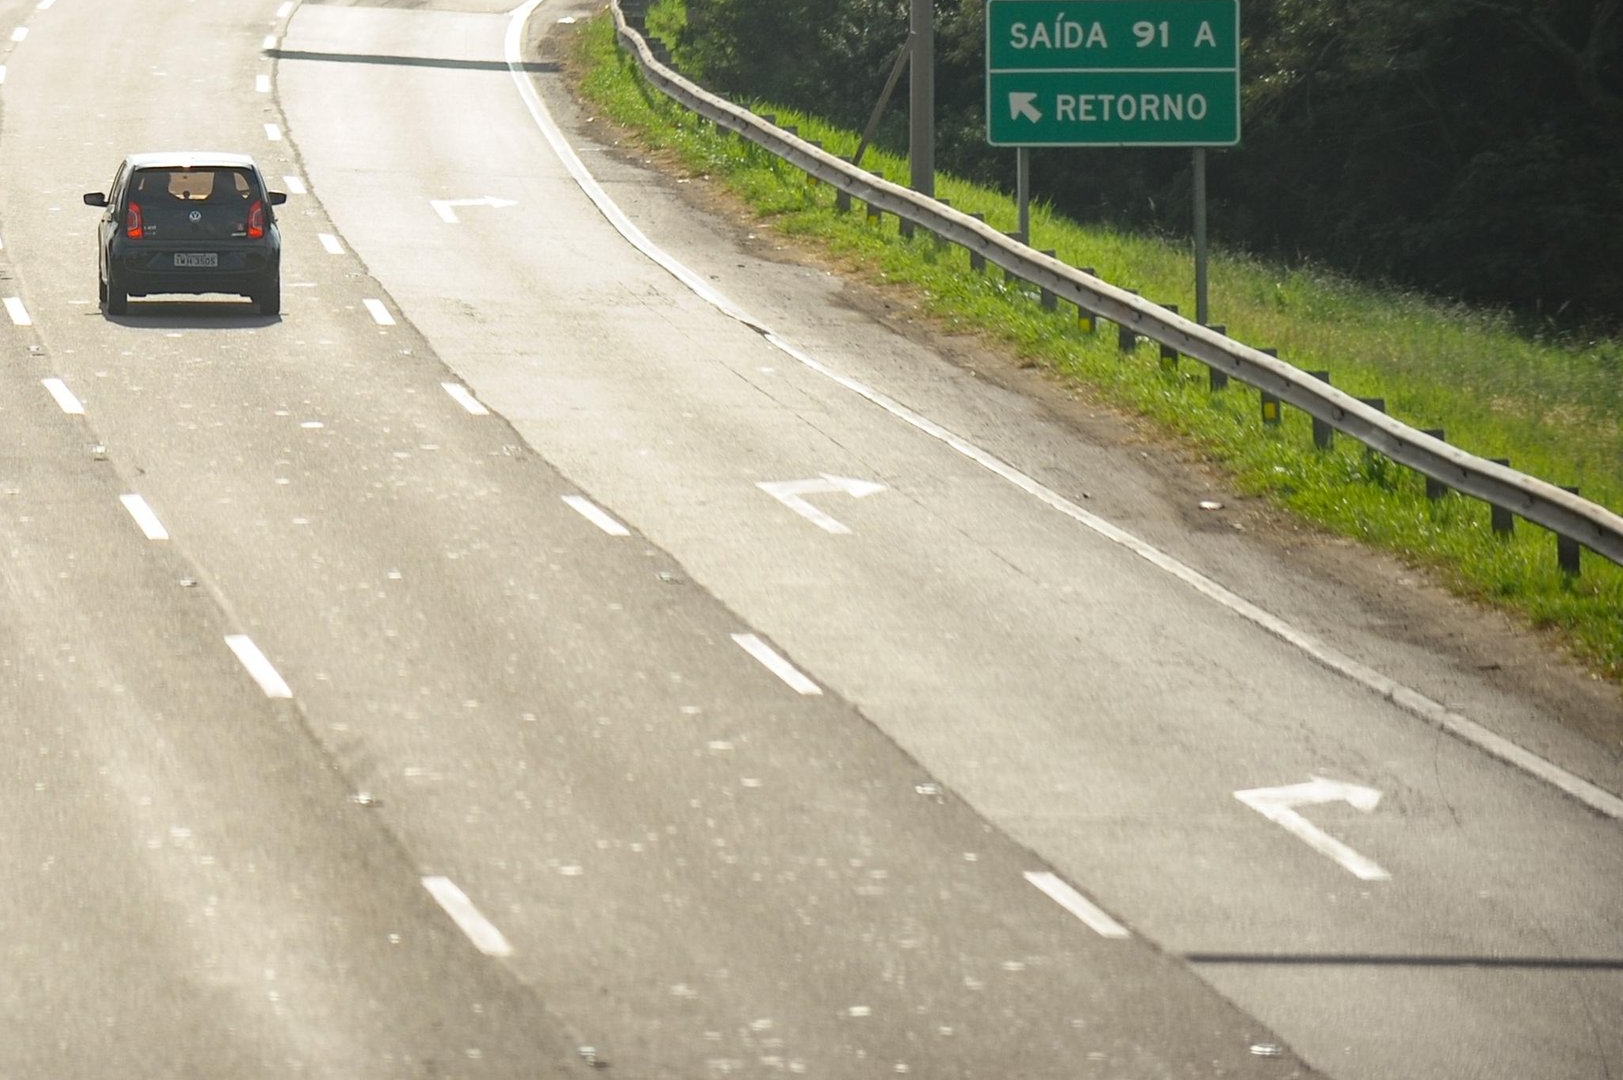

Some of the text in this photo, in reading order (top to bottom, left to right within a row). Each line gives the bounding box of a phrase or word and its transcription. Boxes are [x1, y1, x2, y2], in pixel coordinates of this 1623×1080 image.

[1010, 12, 1217, 49] SAÍDA 91 A
[1056, 93, 1207, 121] RETORNO
